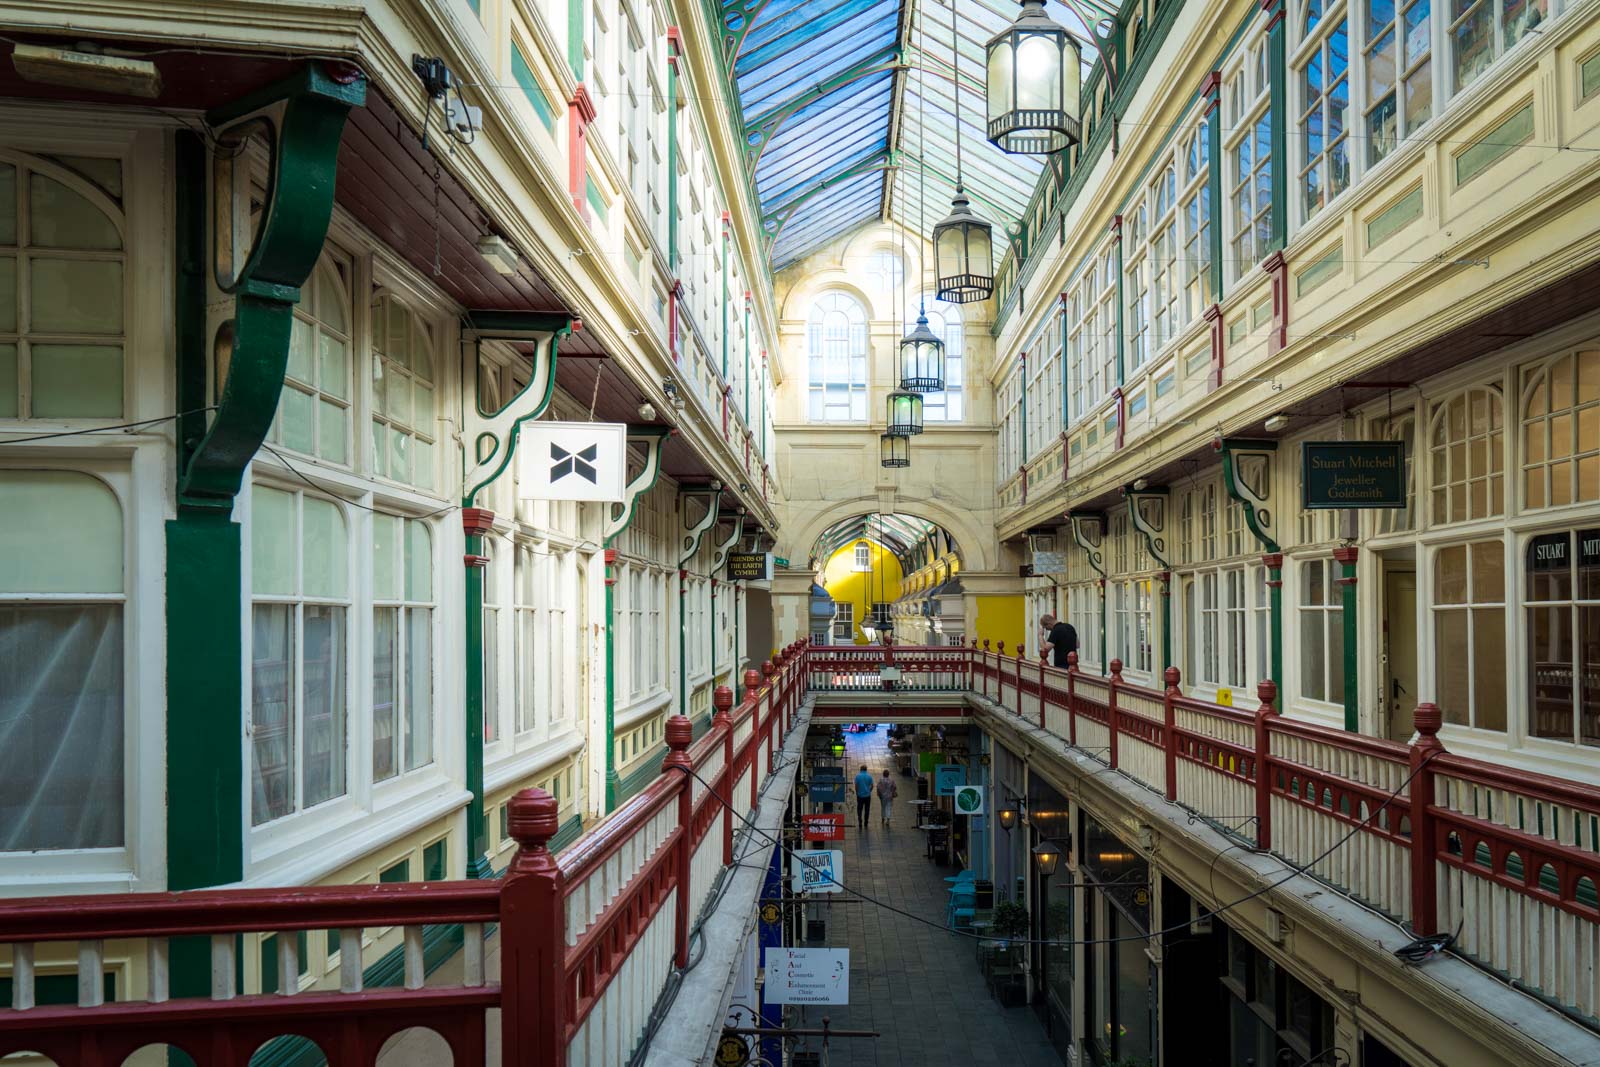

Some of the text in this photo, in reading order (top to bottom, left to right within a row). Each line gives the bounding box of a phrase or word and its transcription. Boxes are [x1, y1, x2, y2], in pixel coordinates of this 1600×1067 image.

[1312, 455, 1395, 468] Stuart Mitchell
[1334, 474, 1376, 486] Jeweller
[1328, 487, 1383, 498] Goldsmith
[1536, 543, 1566, 560] STUART
[788, 951, 806, 959] Facial
[788, 961, 802, 969] And
[787, 970, 814, 978] Cosmetic
[787, 980, 826, 988] Enhancement
